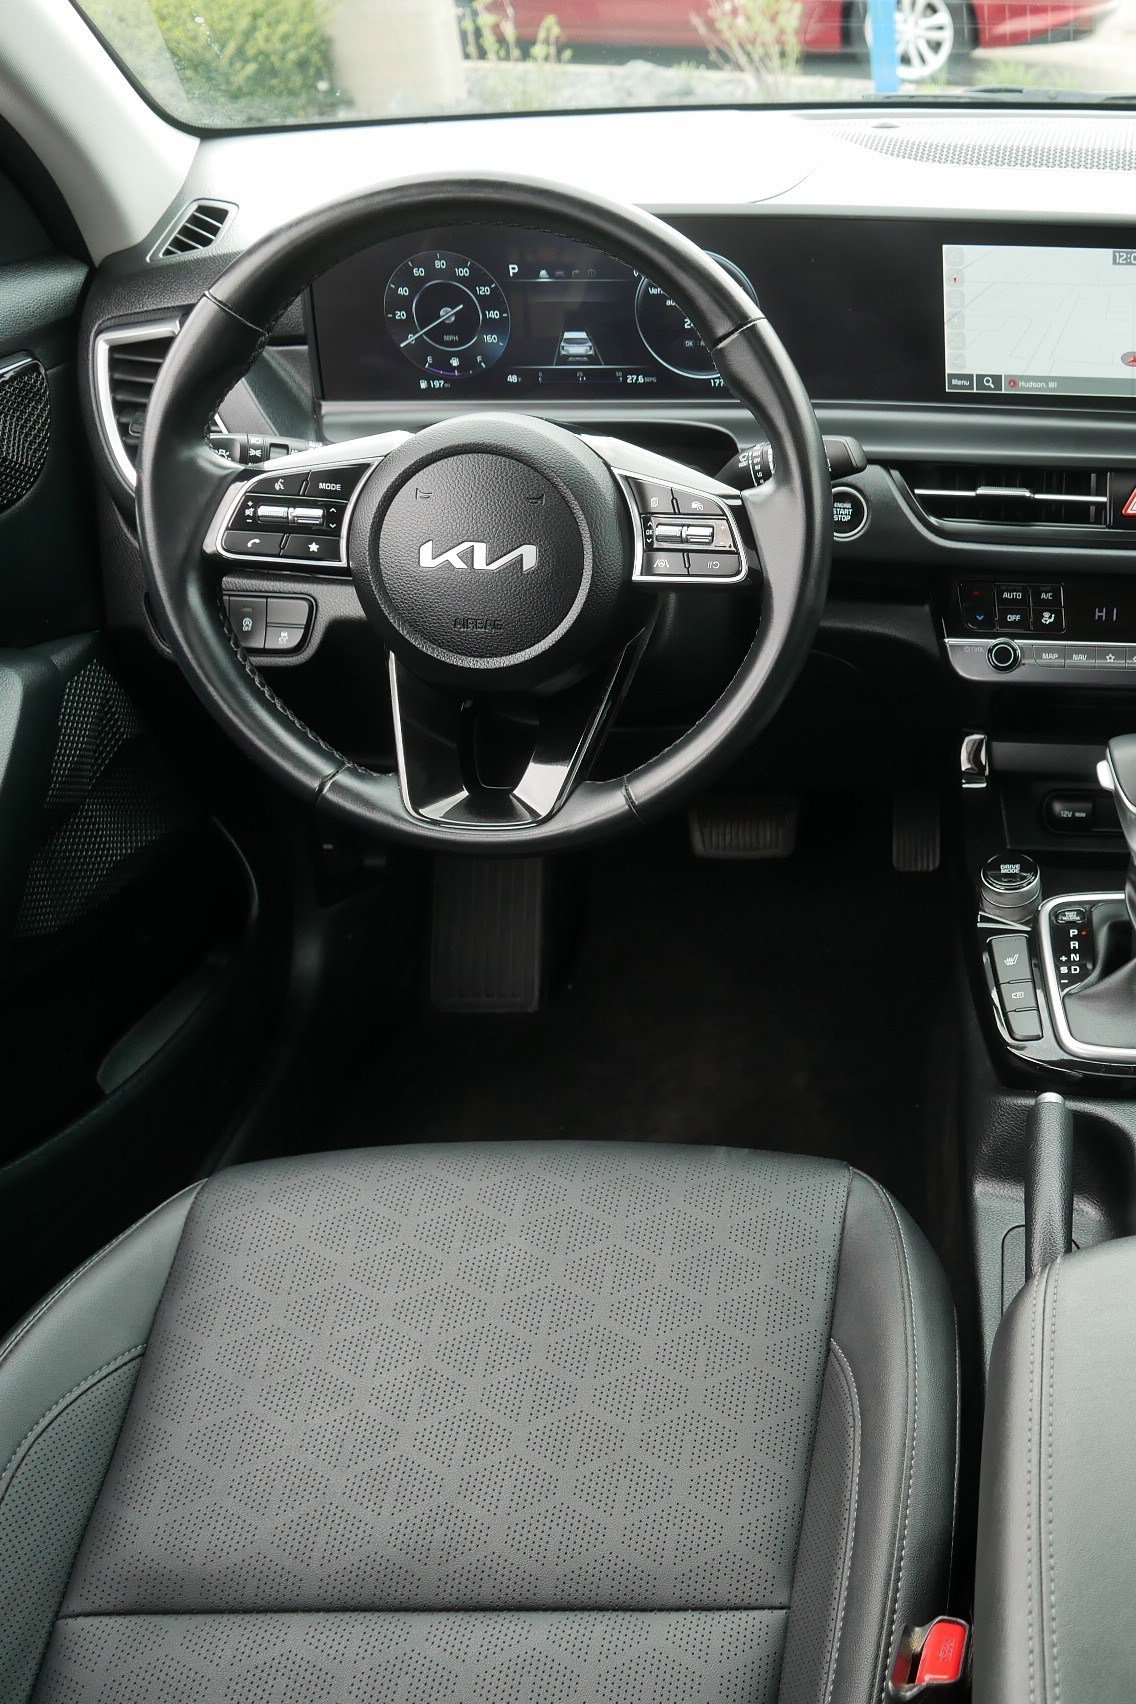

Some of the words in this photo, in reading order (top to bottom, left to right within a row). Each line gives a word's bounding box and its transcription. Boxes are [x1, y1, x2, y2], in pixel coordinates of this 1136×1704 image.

[434, 260, 447, 269] 80
[413, 268, 425, 276] 60
[455, 268, 470, 277] 100
[508, 264, 519, 277] P
[397, 287, 409, 296] 40
[476, 286, 490, 295] 120
[395, 311, 406, 320] 20
[485, 311, 499, 319] 140
[483, 335, 498, 343] 160
[507, 374, 517, 383] 48
[626, 374, 644, 384] 27.6
[951, 378, 970, 386] Menu
[430, 380, 444, 388] 197
[1019, 380, 1047, 389] Hudson,
[318, 482, 342, 491] MODE
[1040, 592, 1053, 600] A/C
[1007, 614, 1021, 622] OFF
[1069, 929, 1078, 938] P
[1070, 941, 1078, 950] R
[1070, 953, 1079, 961] N
[1071, 966, 1080, 974] D
